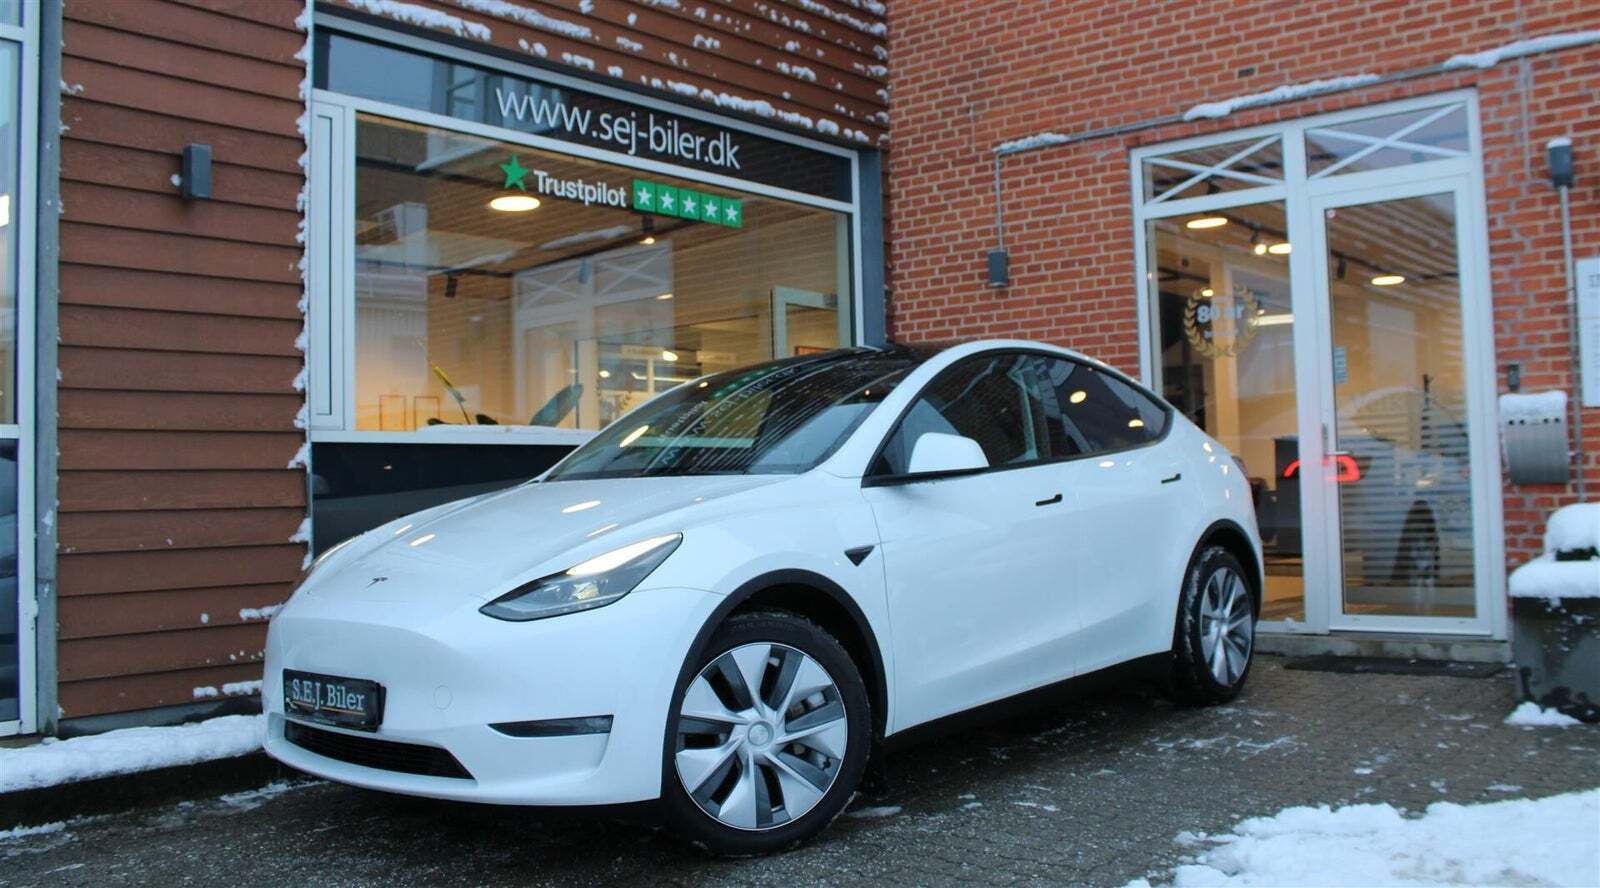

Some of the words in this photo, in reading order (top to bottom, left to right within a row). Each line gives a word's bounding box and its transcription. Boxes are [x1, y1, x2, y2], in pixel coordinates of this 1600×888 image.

[496, 88, 740, 169] www.sej-biler.dk
[534, 170, 627, 207] Trustpilot
[293, 679, 324, 709] S.E.J.
[327, 685, 365, 710] Biler
